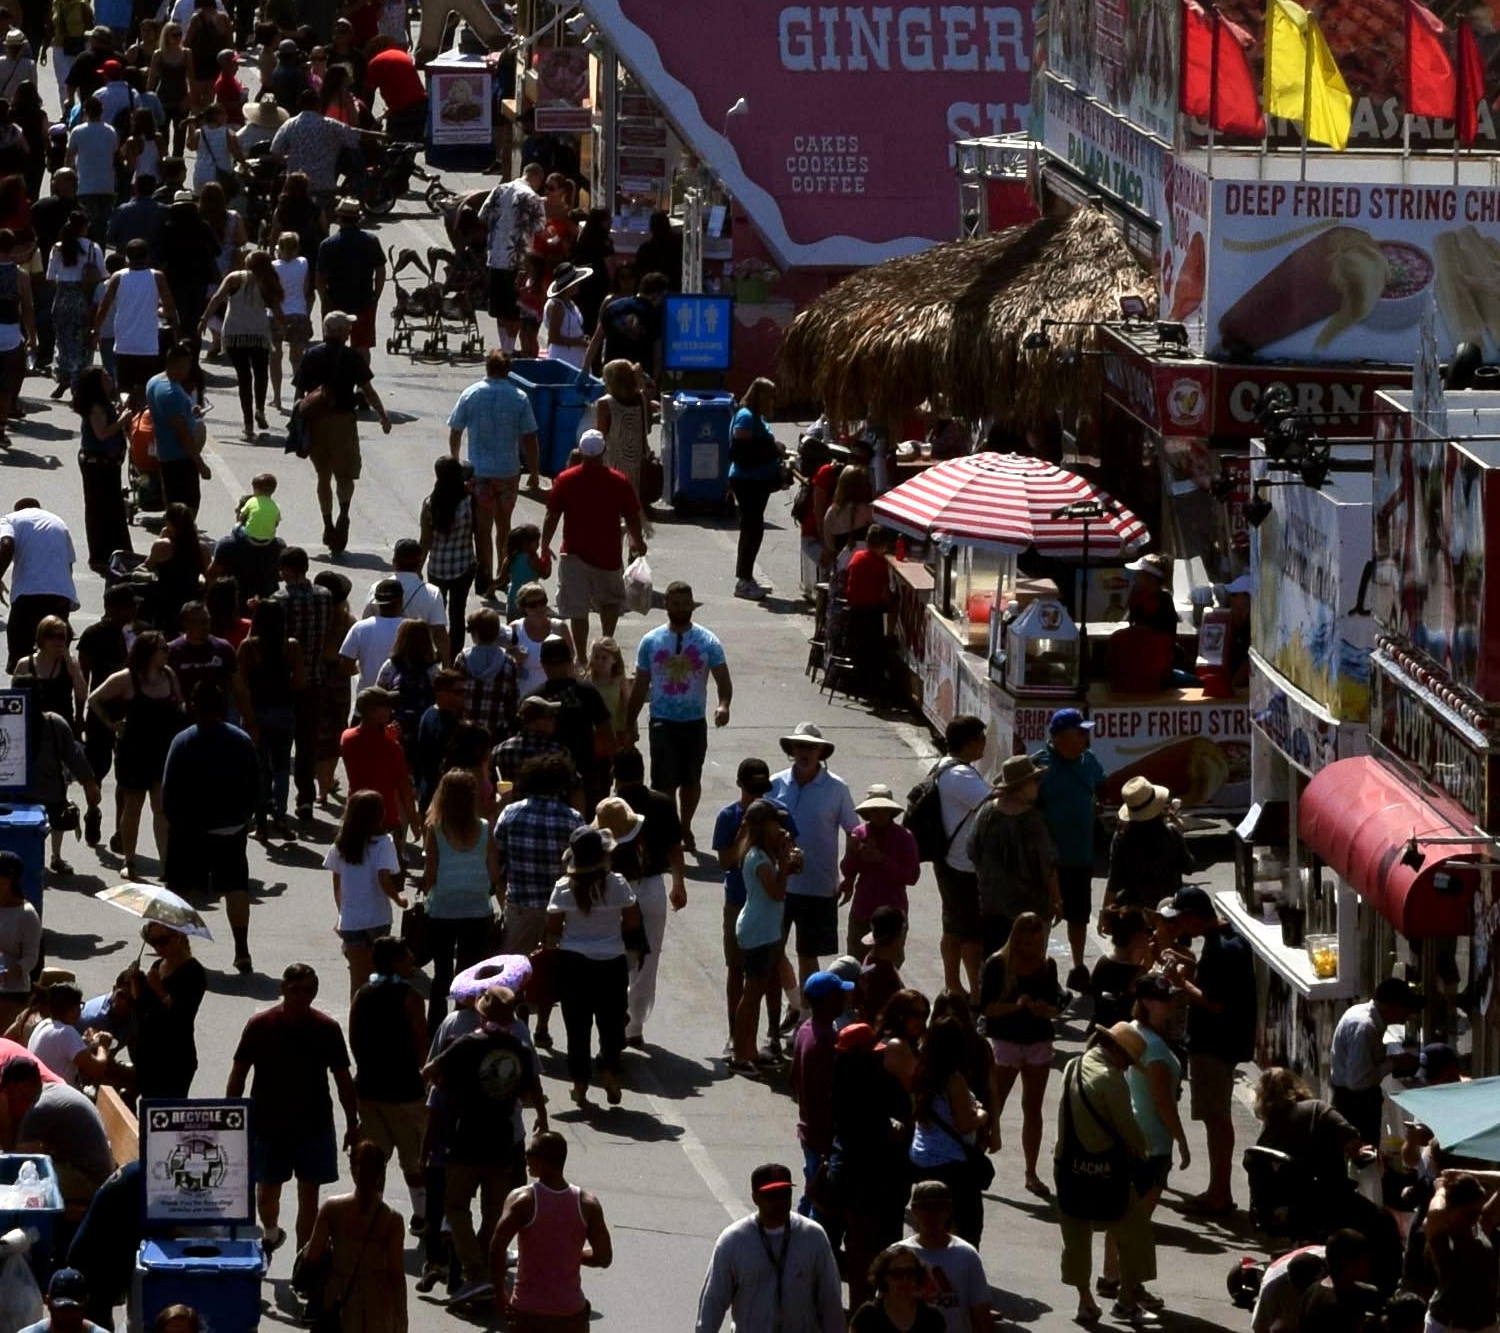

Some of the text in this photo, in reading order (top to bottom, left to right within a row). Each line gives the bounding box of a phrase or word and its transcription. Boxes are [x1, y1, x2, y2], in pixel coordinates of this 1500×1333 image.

[793, 136, 859, 153] CAKES
[786, 156, 869, 174] COOKIES
[791, 176, 865, 194] COFFEE
[1225, 184, 1286, 217] DEEP
[1292, 186, 1361, 219] FRIED
[1368, 188, 1457, 221] STRING
[1094, 713, 1140, 739] DEEP
[1148, 712, 1202, 738] FRIED
[172, 1111, 222, 1123] RECYCLE
